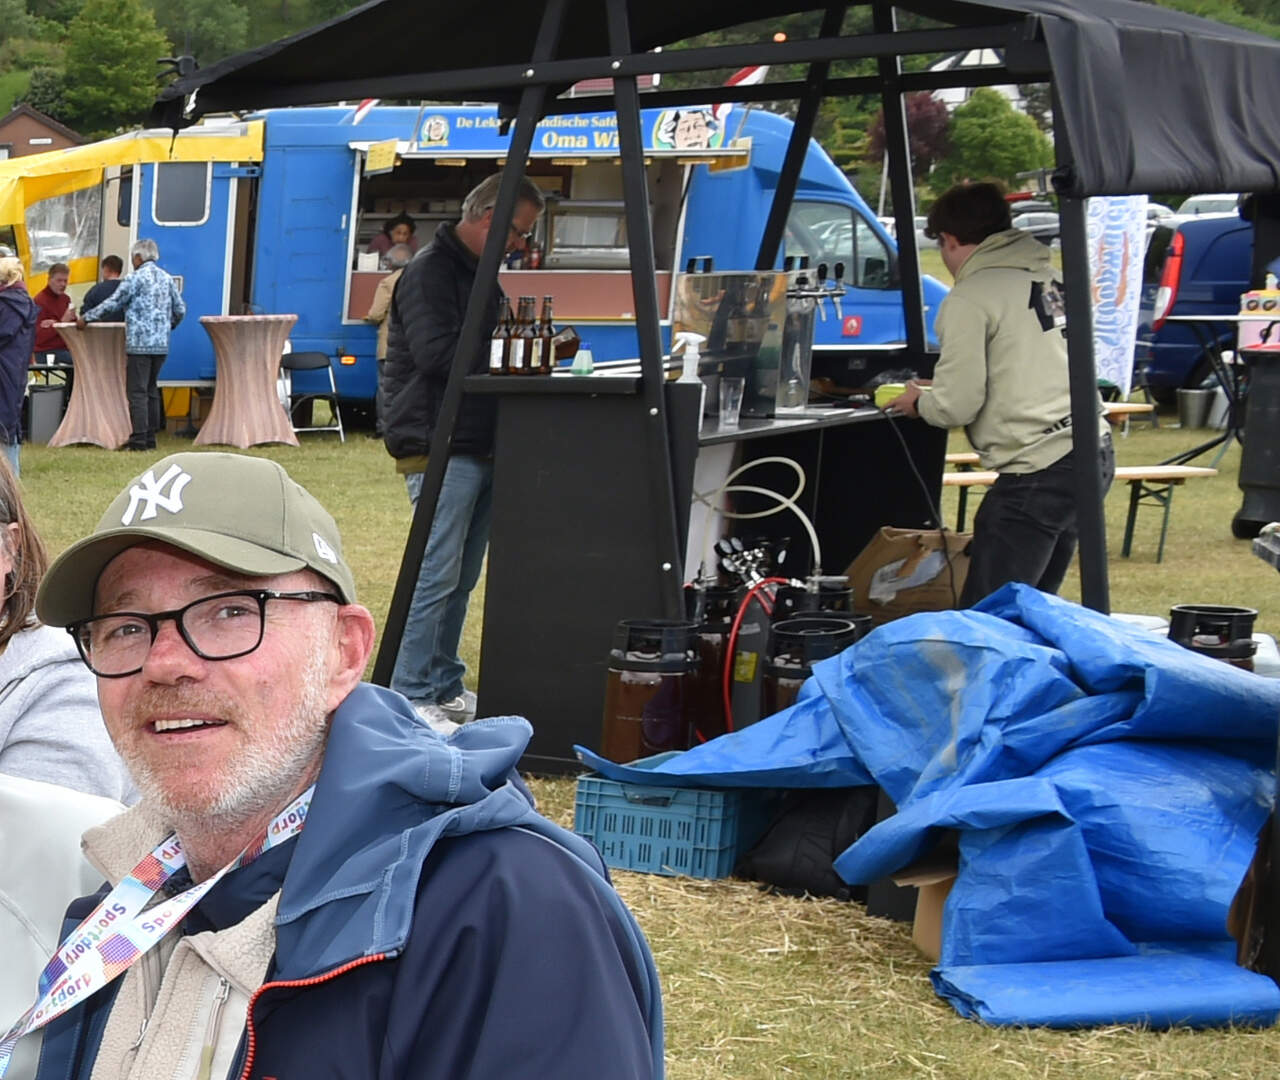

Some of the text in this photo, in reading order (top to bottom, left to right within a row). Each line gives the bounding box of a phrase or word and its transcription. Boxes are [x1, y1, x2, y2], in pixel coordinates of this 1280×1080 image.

[456, 116, 473, 128] De
[537, 115, 589, 127] ndische
[542, 132, 589, 148] Oma
[65, 902, 126, 966] Sportdorp
